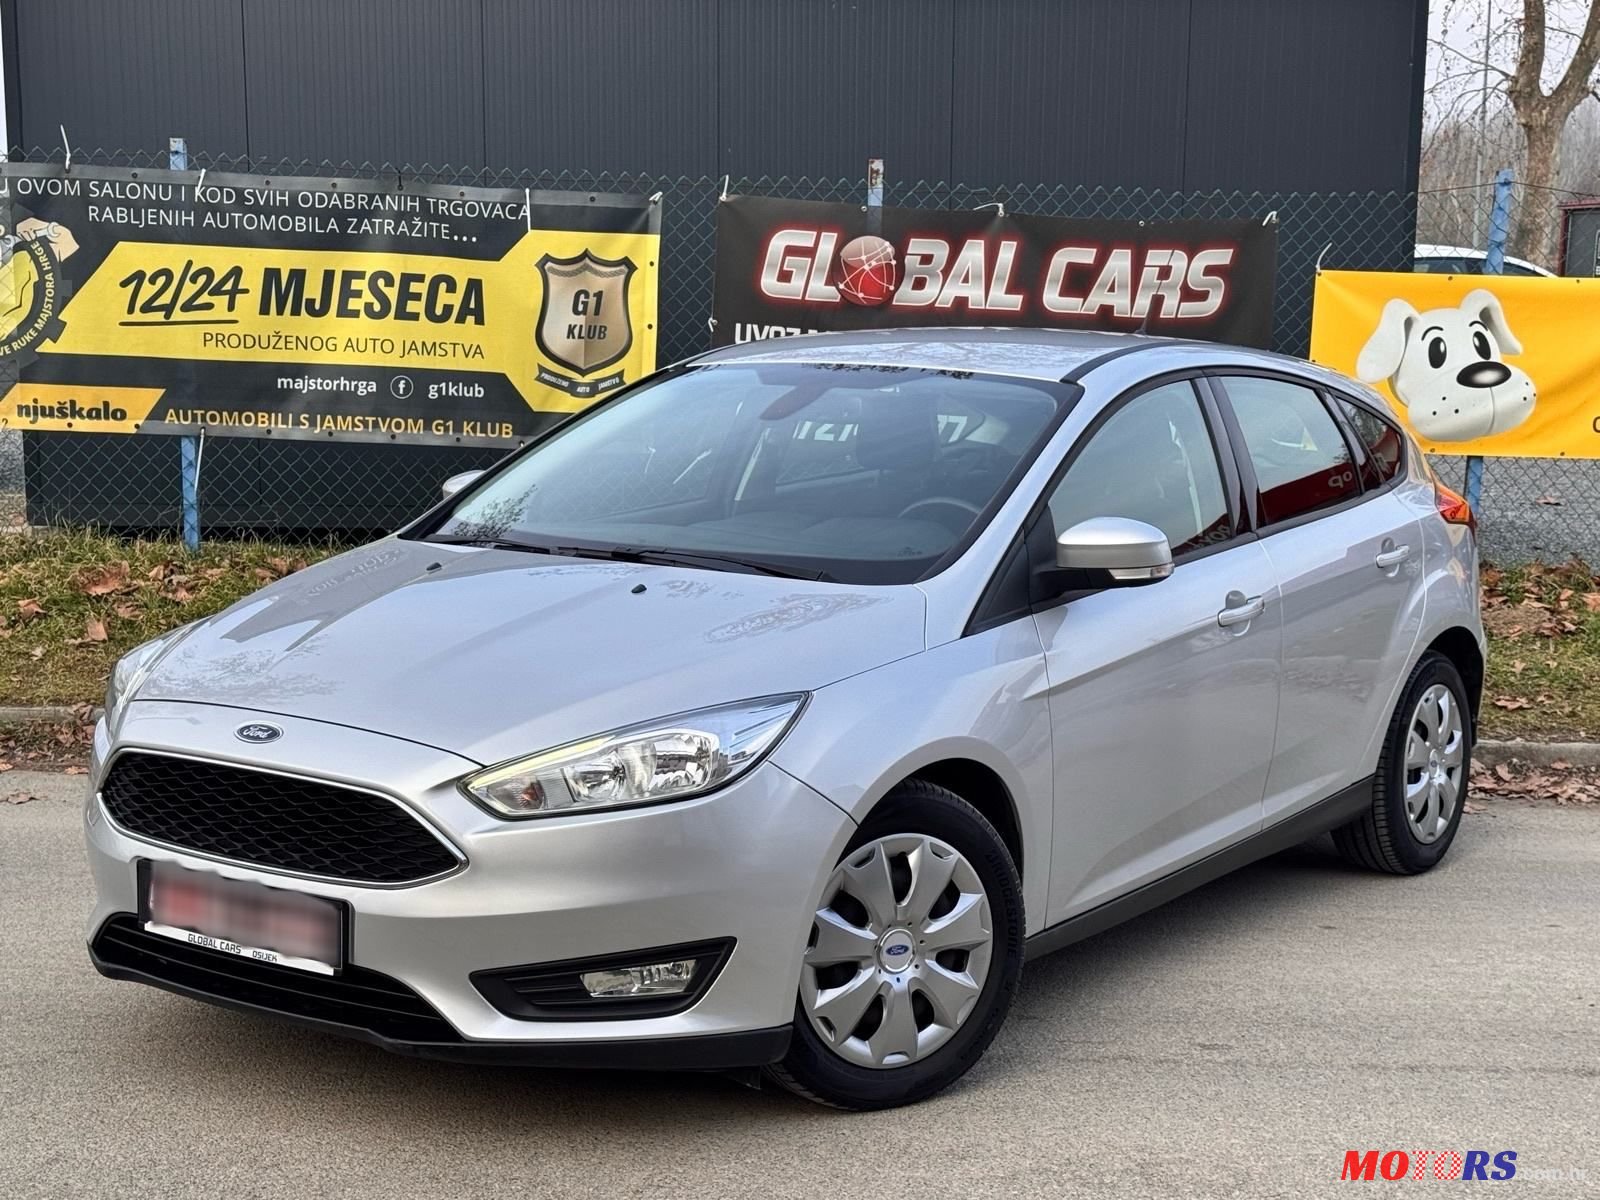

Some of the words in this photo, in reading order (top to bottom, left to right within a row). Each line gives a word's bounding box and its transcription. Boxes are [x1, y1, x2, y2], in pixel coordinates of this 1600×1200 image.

[17, 178, 81, 197] OVOM
[89, 181, 172, 202] SALONU
[181, 186, 186, 202] I
[195, 186, 236, 205] KOD
[244, 189, 290, 208] SVIH
[297, 192, 420, 213] ODABRANIH
[426, 198, 530, 221] TRGOVACA
[88, 205, 195, 228] RABLJENIH
[202, 212, 340, 234] AUTOMOBILA
[347, 216, 478, 243] ZATRAŽITE...
[31, 241, 52, 272] HRGE
[760, 229, 1024, 311] GLOBAL
[1043, 246, 1235, 319] CARS
[38, 273, 55, 332] MAJSTORA
[119, 259, 250, 321] 12/24
[258, 266, 485, 327] MJESECA
[571, 289, 604, 317] G1
[11, 328, 38, 352] RUKE
[203, 330, 338, 353] PRODUŽENOG
[343, 336, 395, 355] AUTO
[399, 340, 485, 360] JAMSTVA
[566, 323, 608, 341] KLUB
[277, 375, 377, 396] majstorhrga
[428, 381, 485, 402] g1klub
[16, 397, 128, 425] njuškalo
[164, 408, 293, 430] AUTOMOBILI
[300, 413, 309, 430] S
[314, 414, 424, 435] JAMSTVOM
[432, 418, 455, 436] G1
[463, 420, 514, 438] KLUB
[187, 932, 218, 949] GLOBAL
[219, 941, 242, 954] CARS
[252, 950, 278, 962] OSIJEK
